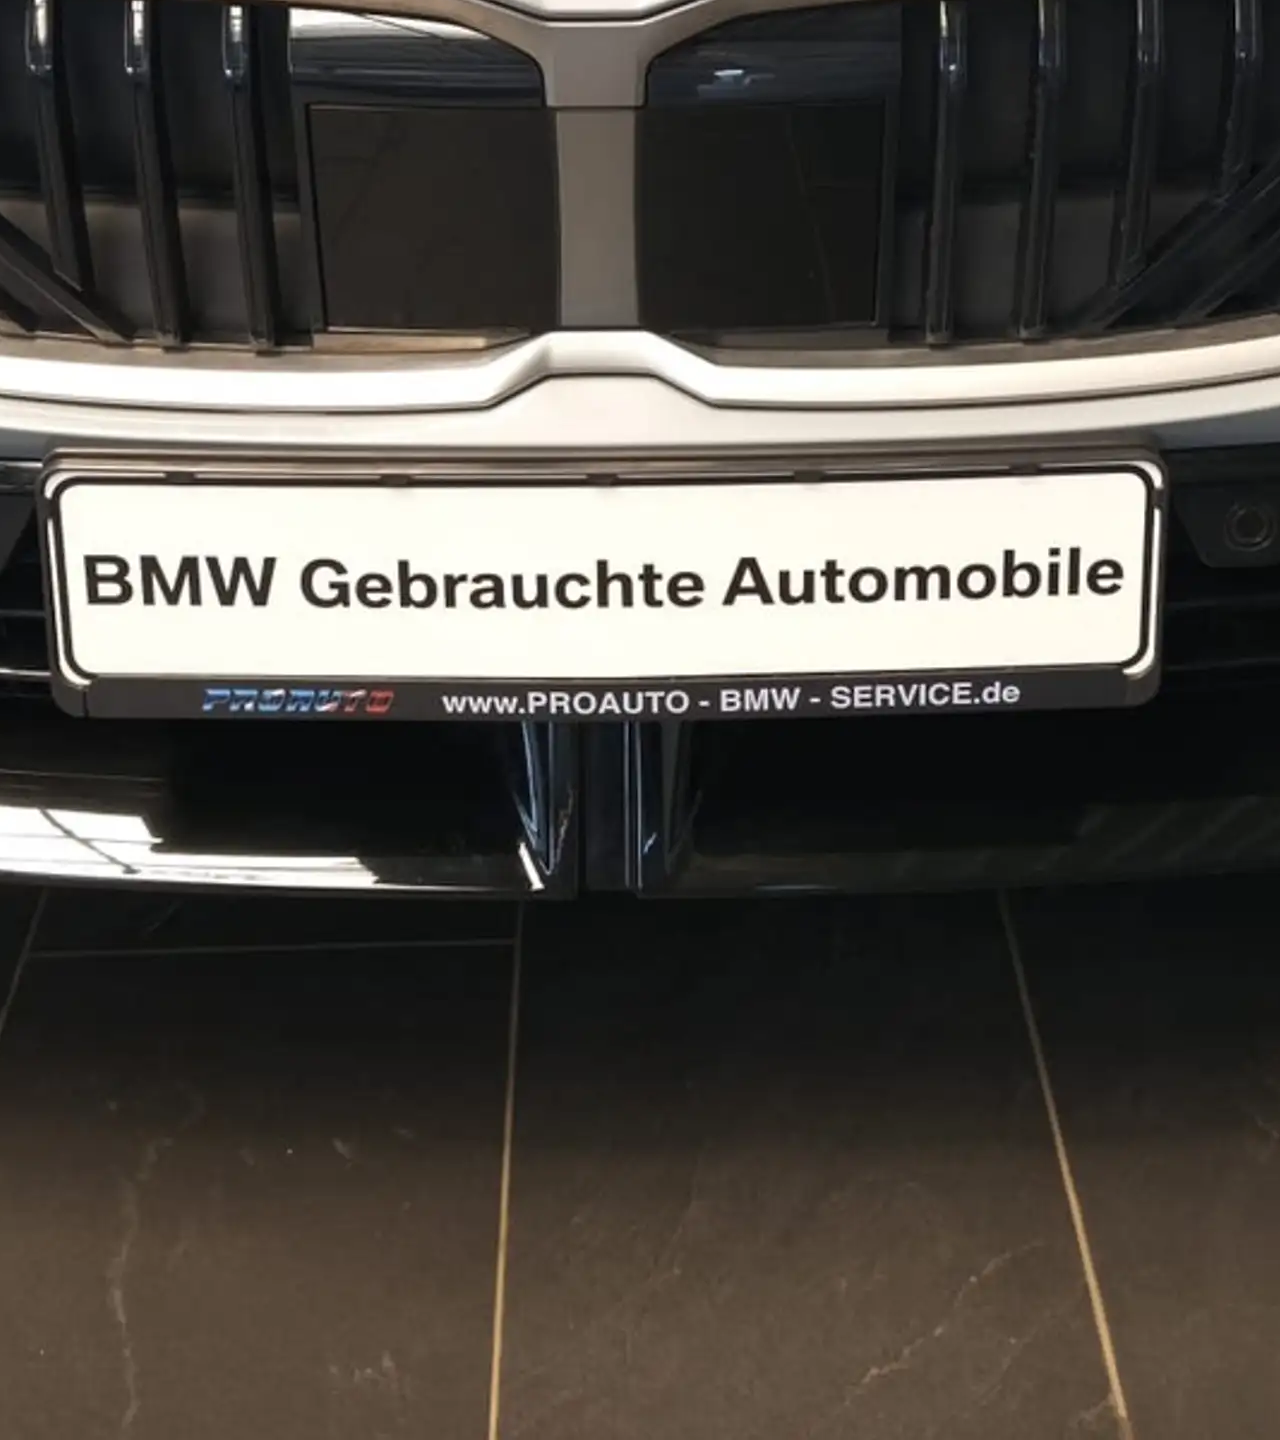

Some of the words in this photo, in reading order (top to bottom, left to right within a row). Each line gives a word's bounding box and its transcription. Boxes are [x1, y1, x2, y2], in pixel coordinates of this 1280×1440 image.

[83, 554, 277, 607] BMW
[300, 558, 706, 610] Gebrauchte
[722, 546, 1125, 606] Automobile
[442, 690, 690, 716] www.PROAUTO
[720, 686, 802, 713] BMW
[830, 681, 1021, 710] SERVICE.de
